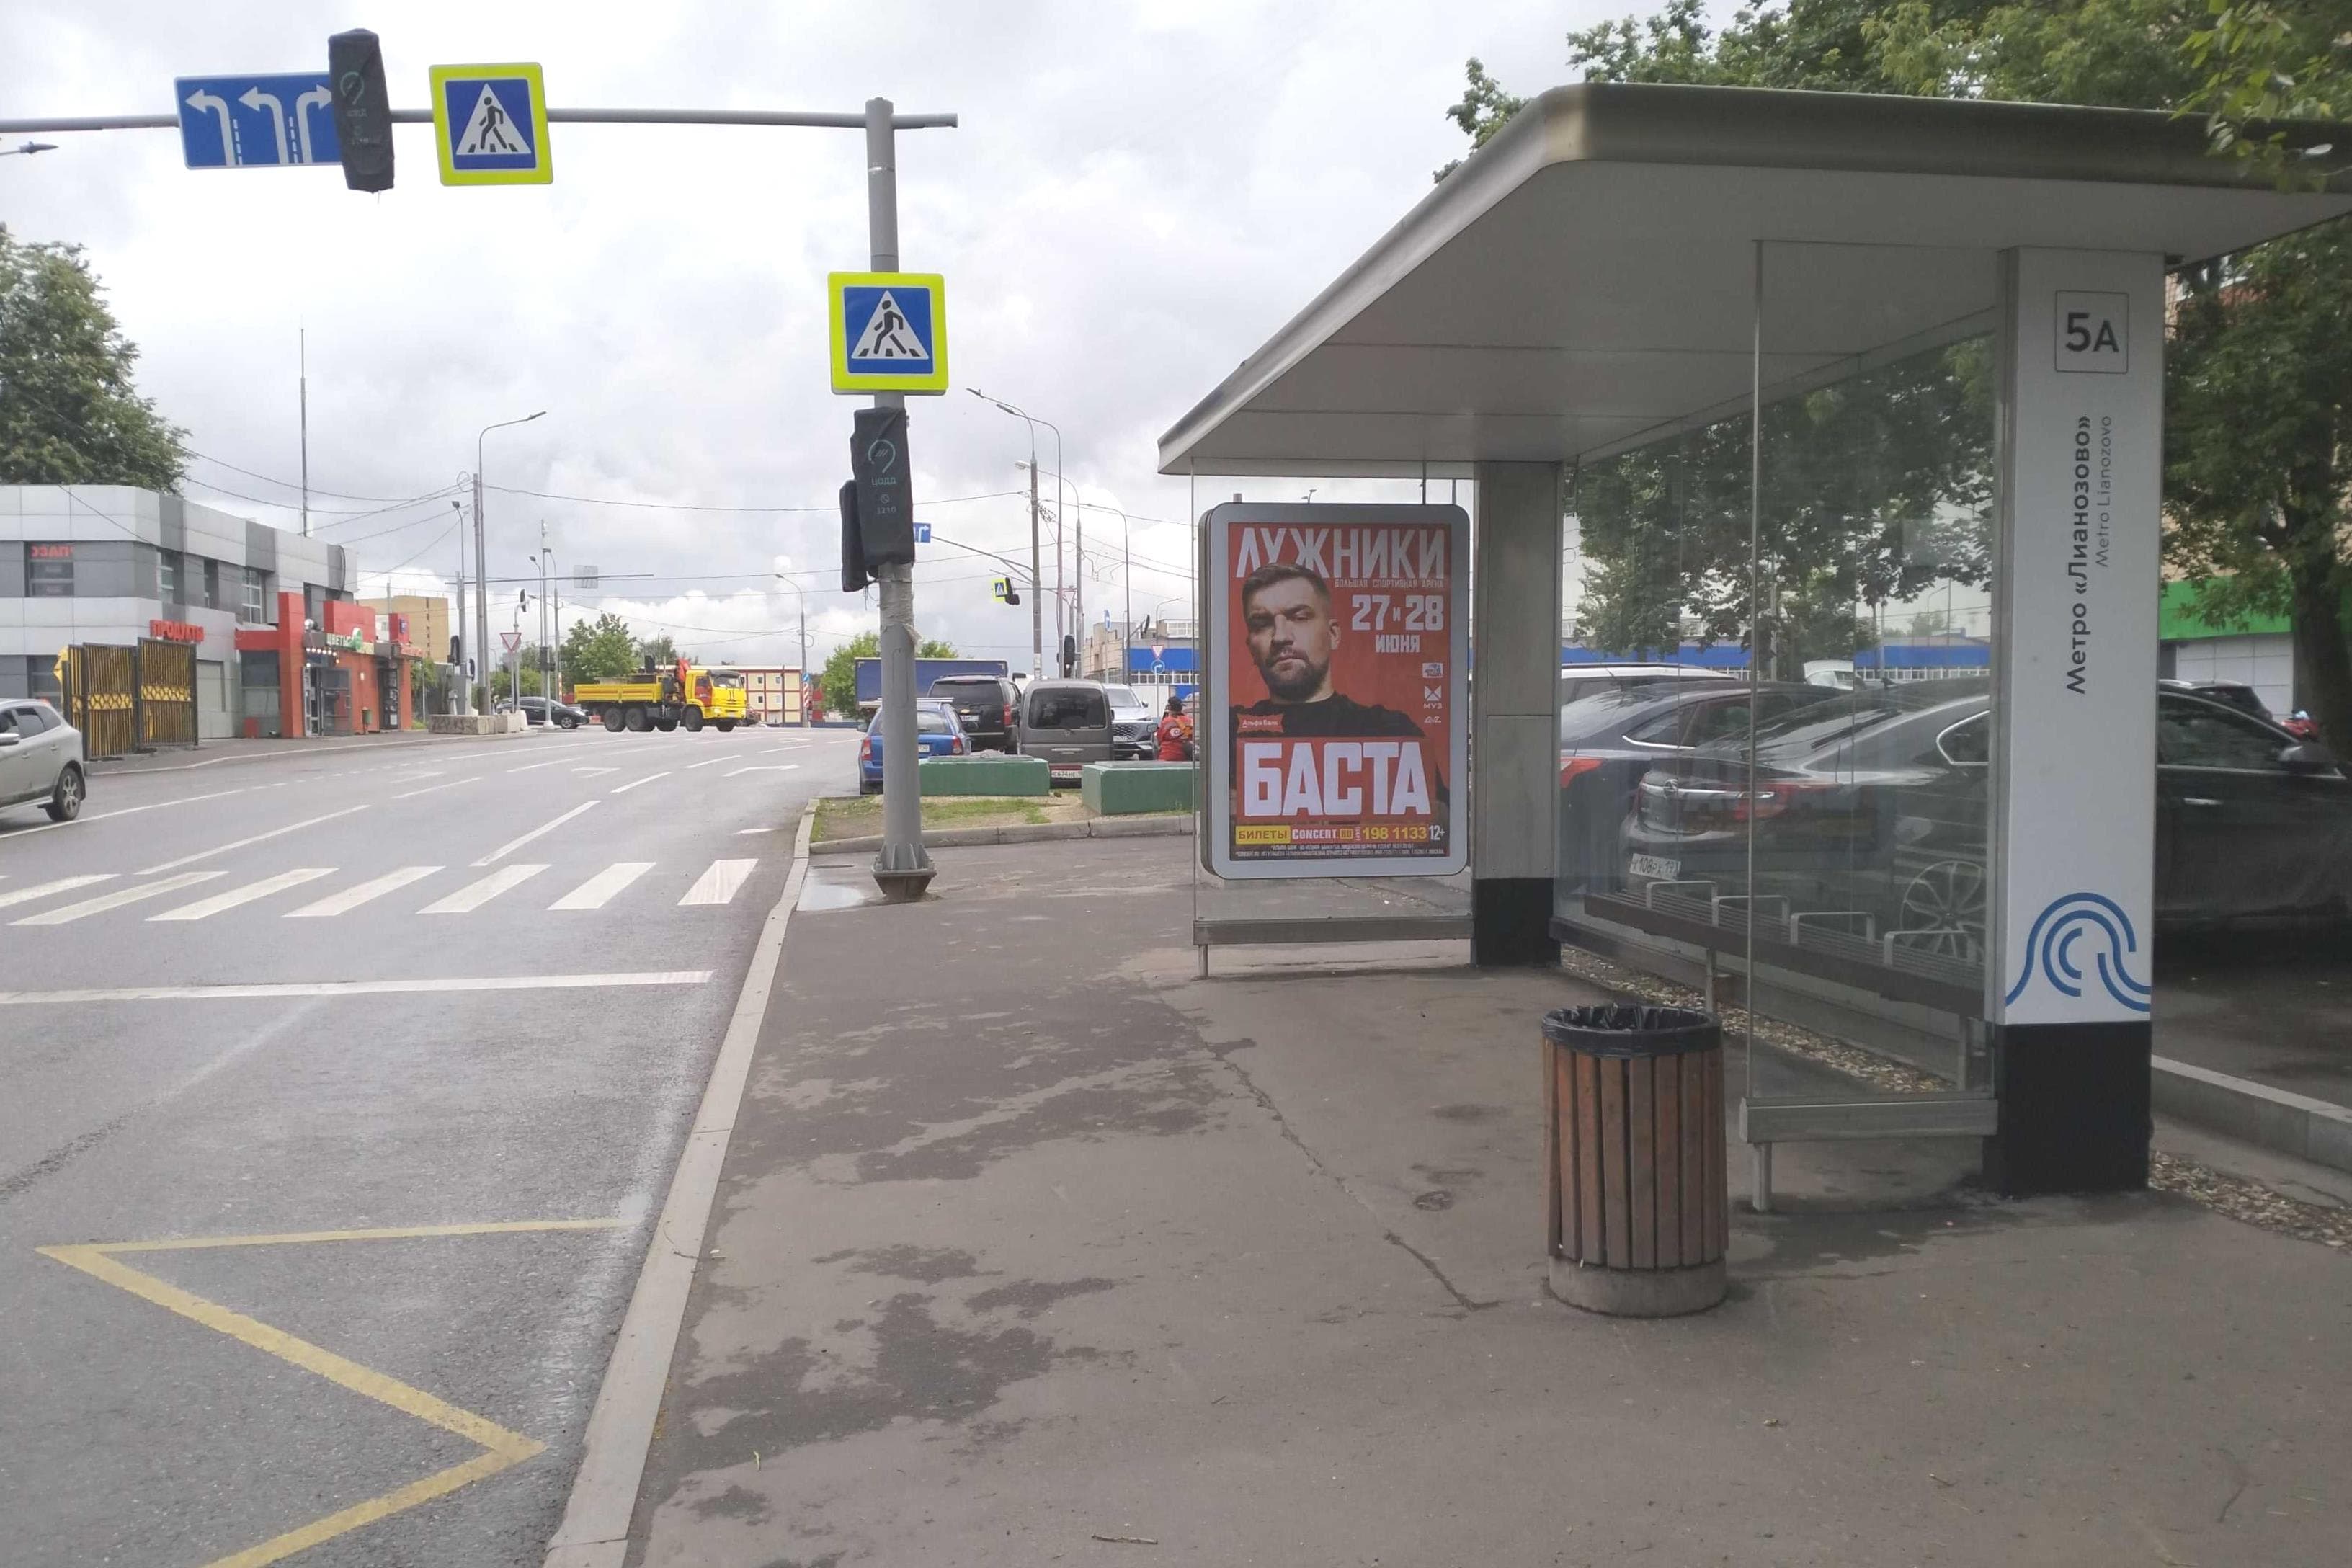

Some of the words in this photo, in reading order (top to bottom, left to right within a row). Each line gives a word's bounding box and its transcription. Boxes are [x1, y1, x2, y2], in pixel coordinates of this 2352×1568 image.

[2097, 416, 2112, 506] Lianozovo
[2068, 416, 2091, 594] «Лианозово»
[1236, 527, 1445, 579] ЛУЖНИКИ
[2095, 512, 2110, 568] Metro
[1351, 594, 1390, 631] 27
[1405, 594, 1444, 631] 28
[1375, 634, 1421, 653] ИЮНЯ
[2067, 602, 2091, 694] Метро
[1244, 741, 1432, 816] БАСТА
[1239, 829, 1288, 840] БИЛЕТЫ
[1391, 827, 1427, 839] 1133
[1429, 824, 1446, 841] 12+
